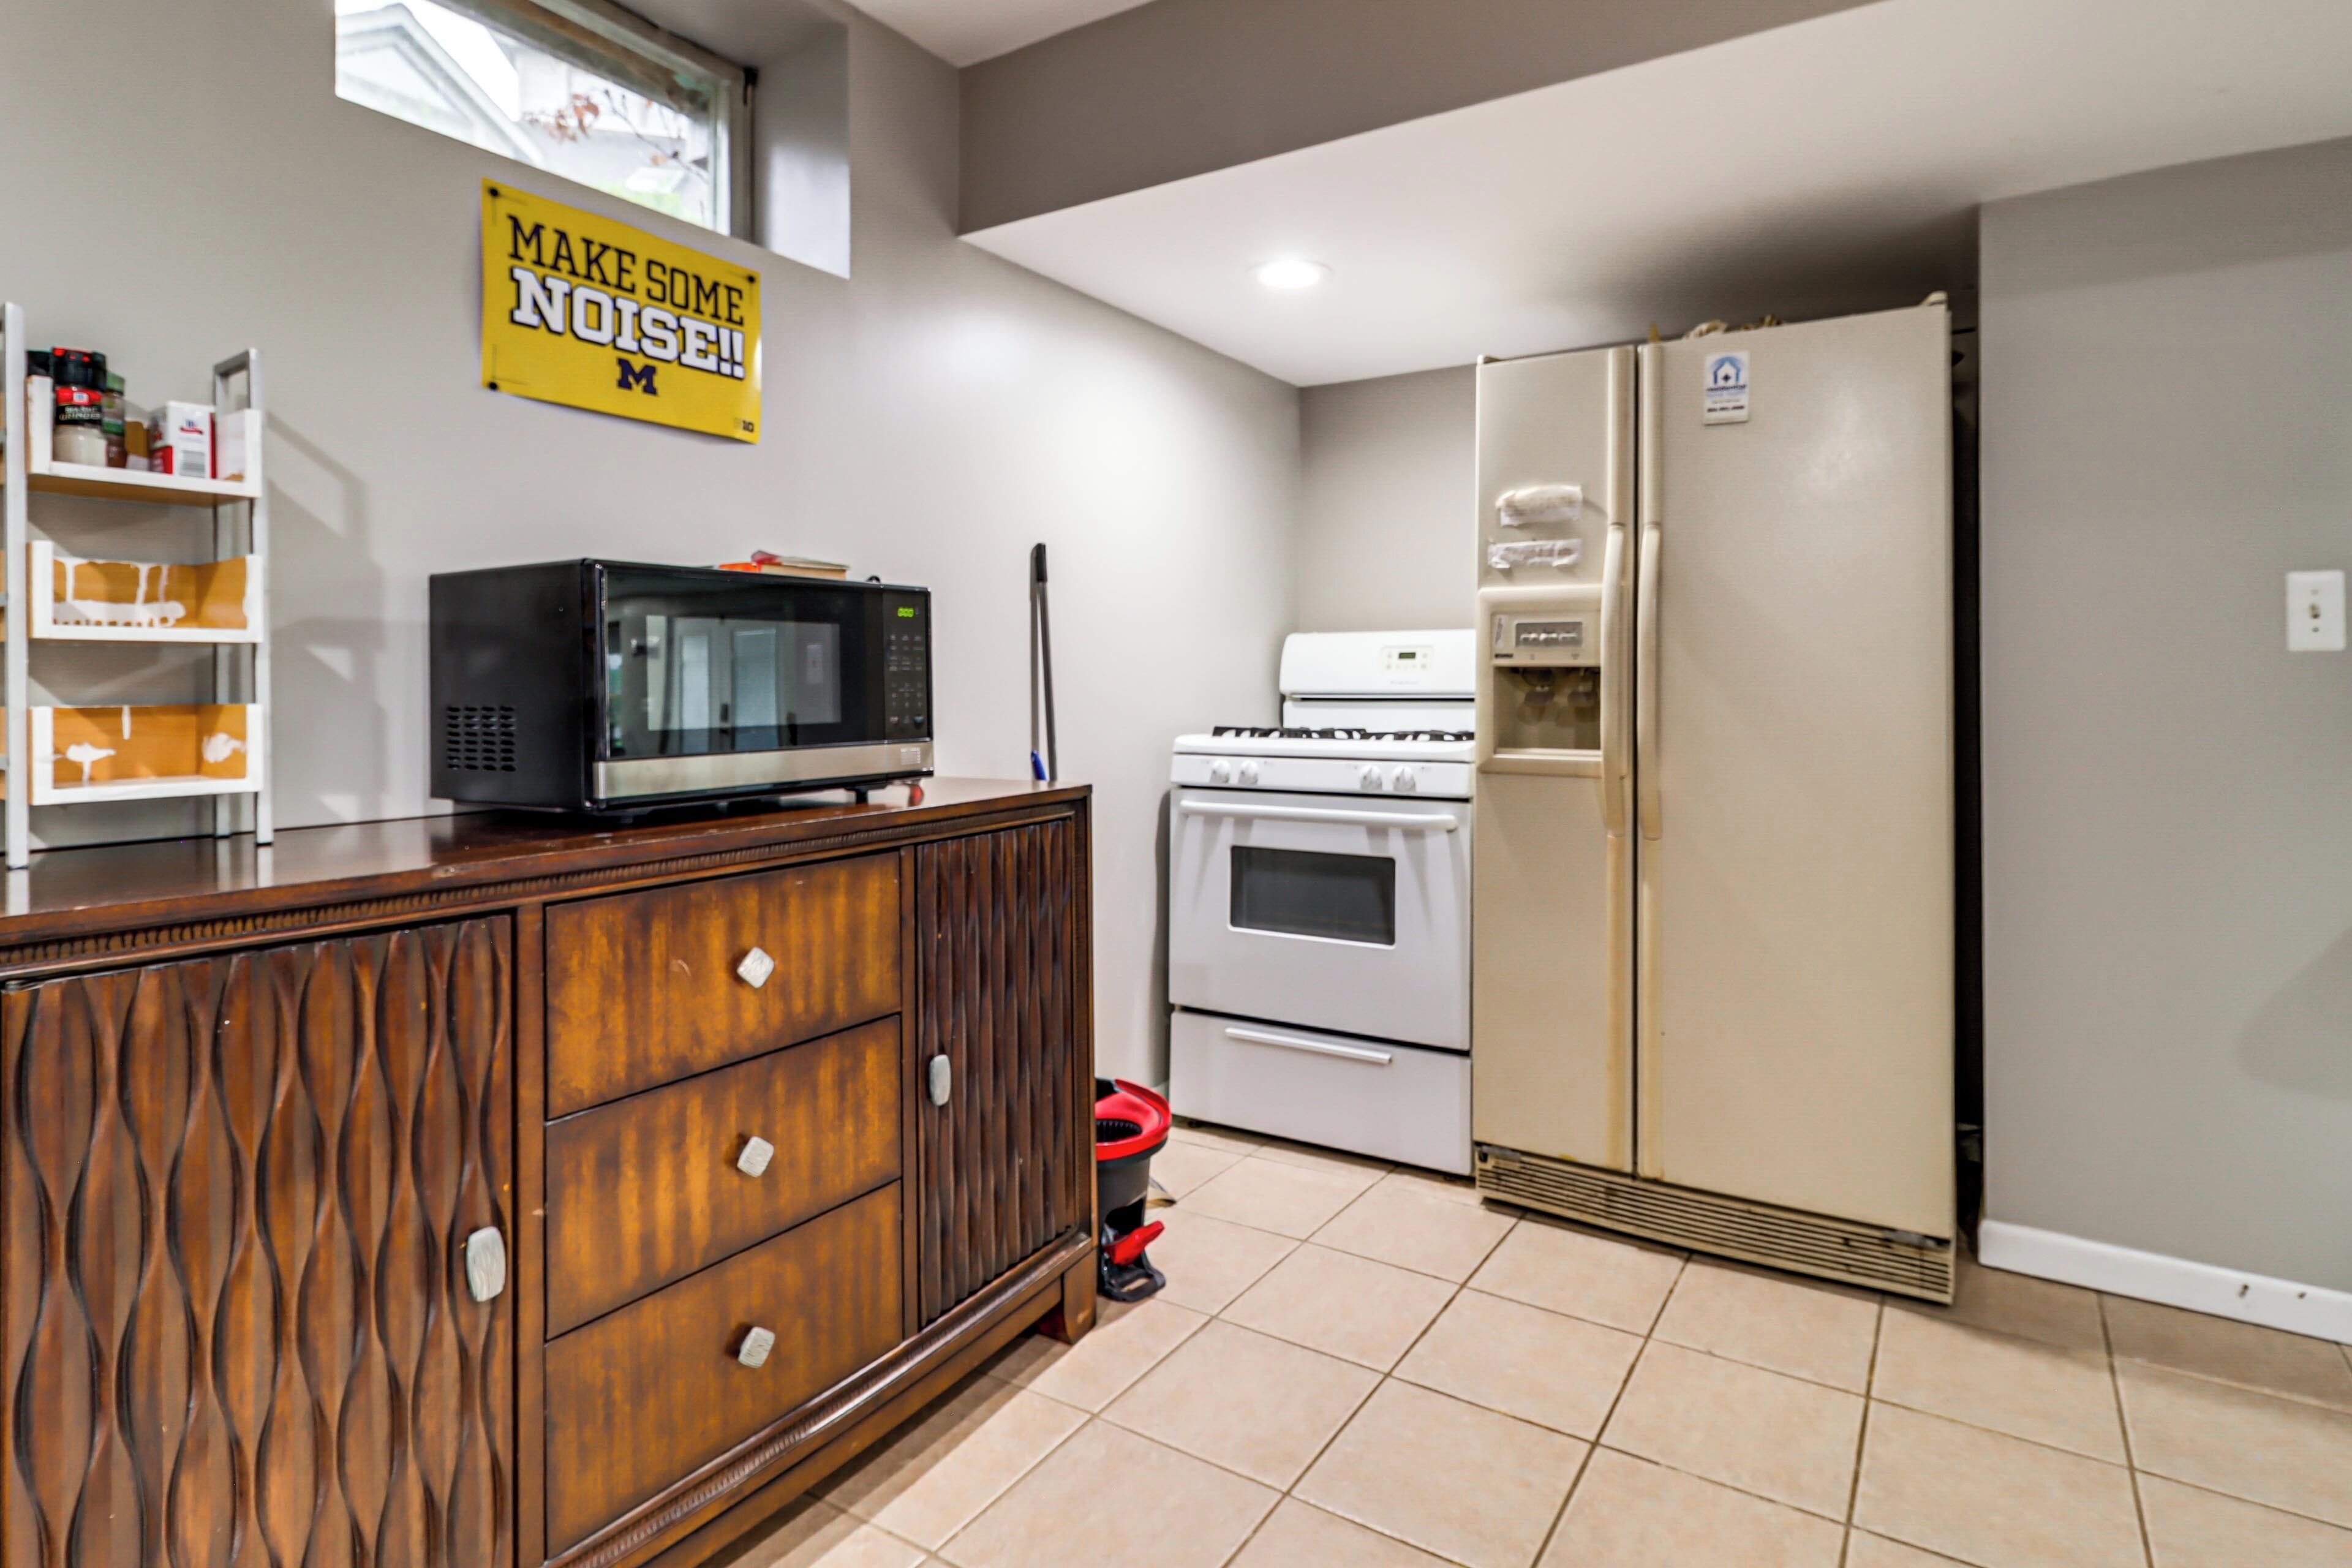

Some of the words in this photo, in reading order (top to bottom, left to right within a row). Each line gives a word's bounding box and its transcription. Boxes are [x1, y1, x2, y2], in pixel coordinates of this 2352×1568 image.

[507, 214, 636, 294] MAKE
[646, 259, 744, 326] SOME
[510, 266, 745, 380] NOISE!!
[617, 358, 658, 396] M
